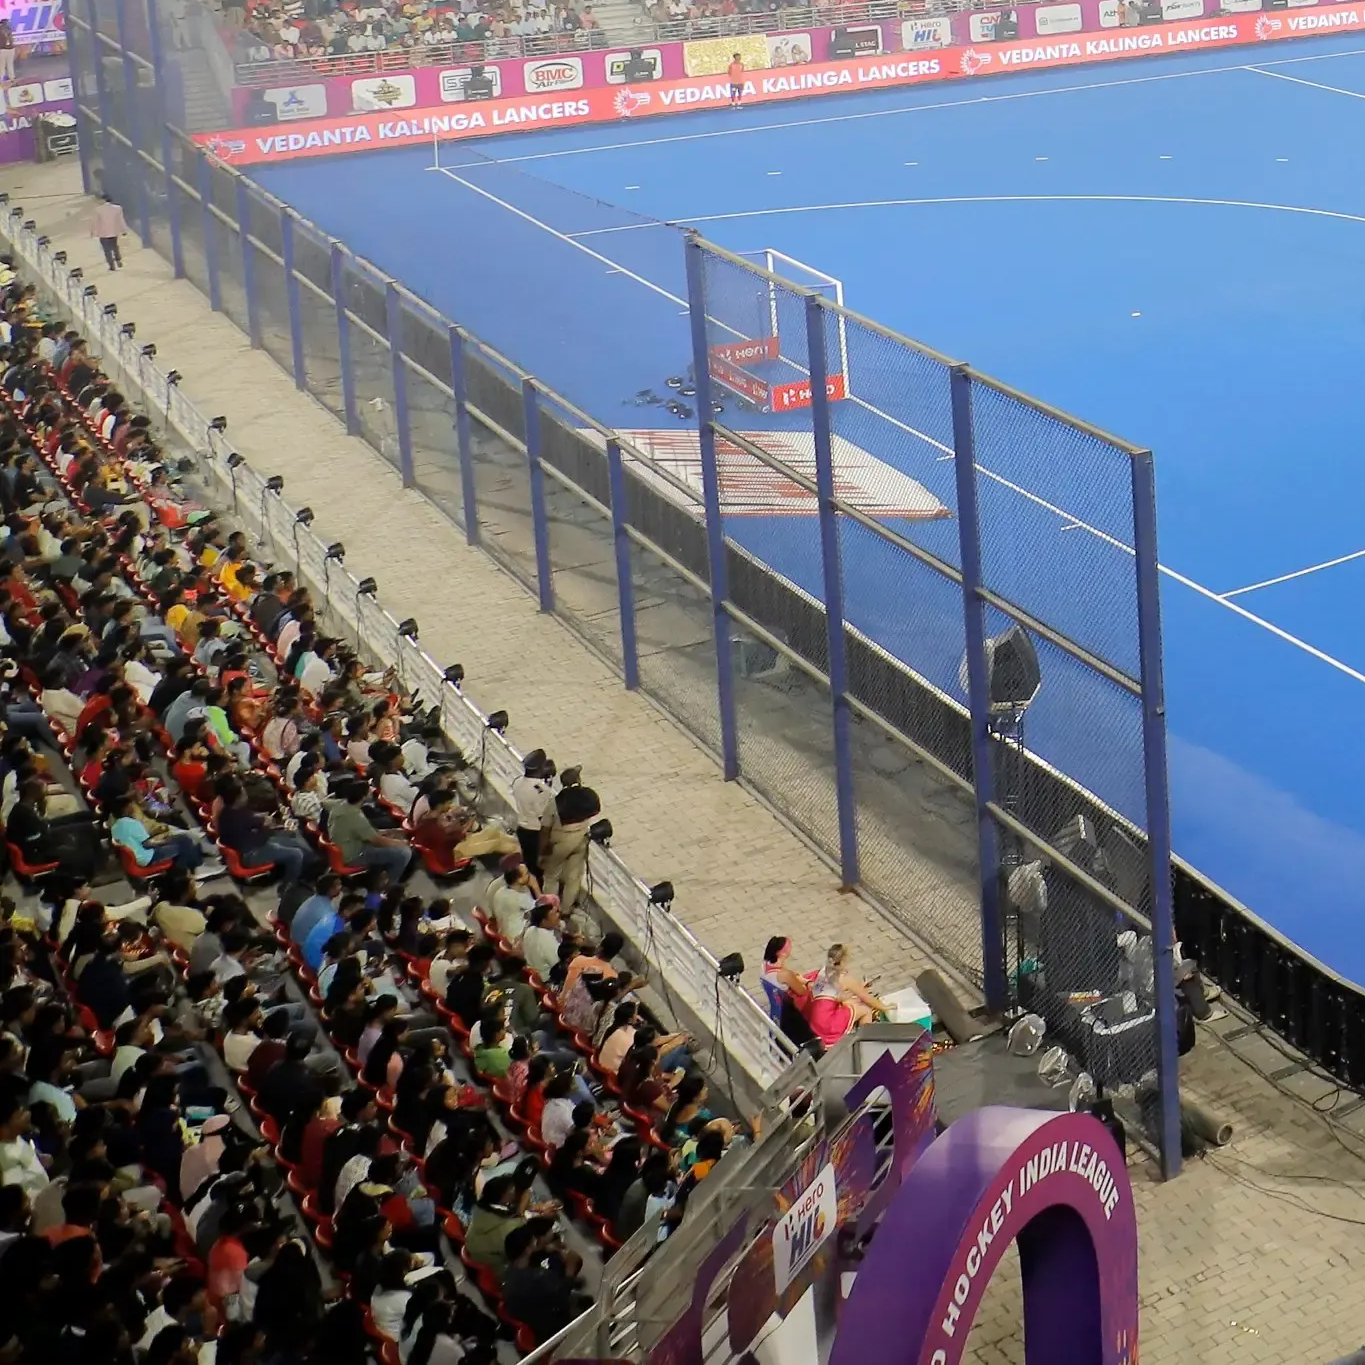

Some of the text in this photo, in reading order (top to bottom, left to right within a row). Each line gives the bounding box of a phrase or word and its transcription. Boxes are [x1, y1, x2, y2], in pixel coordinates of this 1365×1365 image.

[1287, 11, 1359, 31] VEDANTA
[999, 23, 1238, 65] VEDANTA KALINGA LANCERS
[535, 66, 573, 82] BMC
[659, 59, 941, 106] VEDANA KALINGA LANCERS
[256, 99, 590, 154] VEDANTA KALINGA LANCERS
[798, 1181, 824, 1219] Hero
[941, 1179, 1015, 1337] HOCKEY
[1019, 1140, 1068, 1197] INDIA
[1071, 1140, 1120, 1221] LEAGUE
